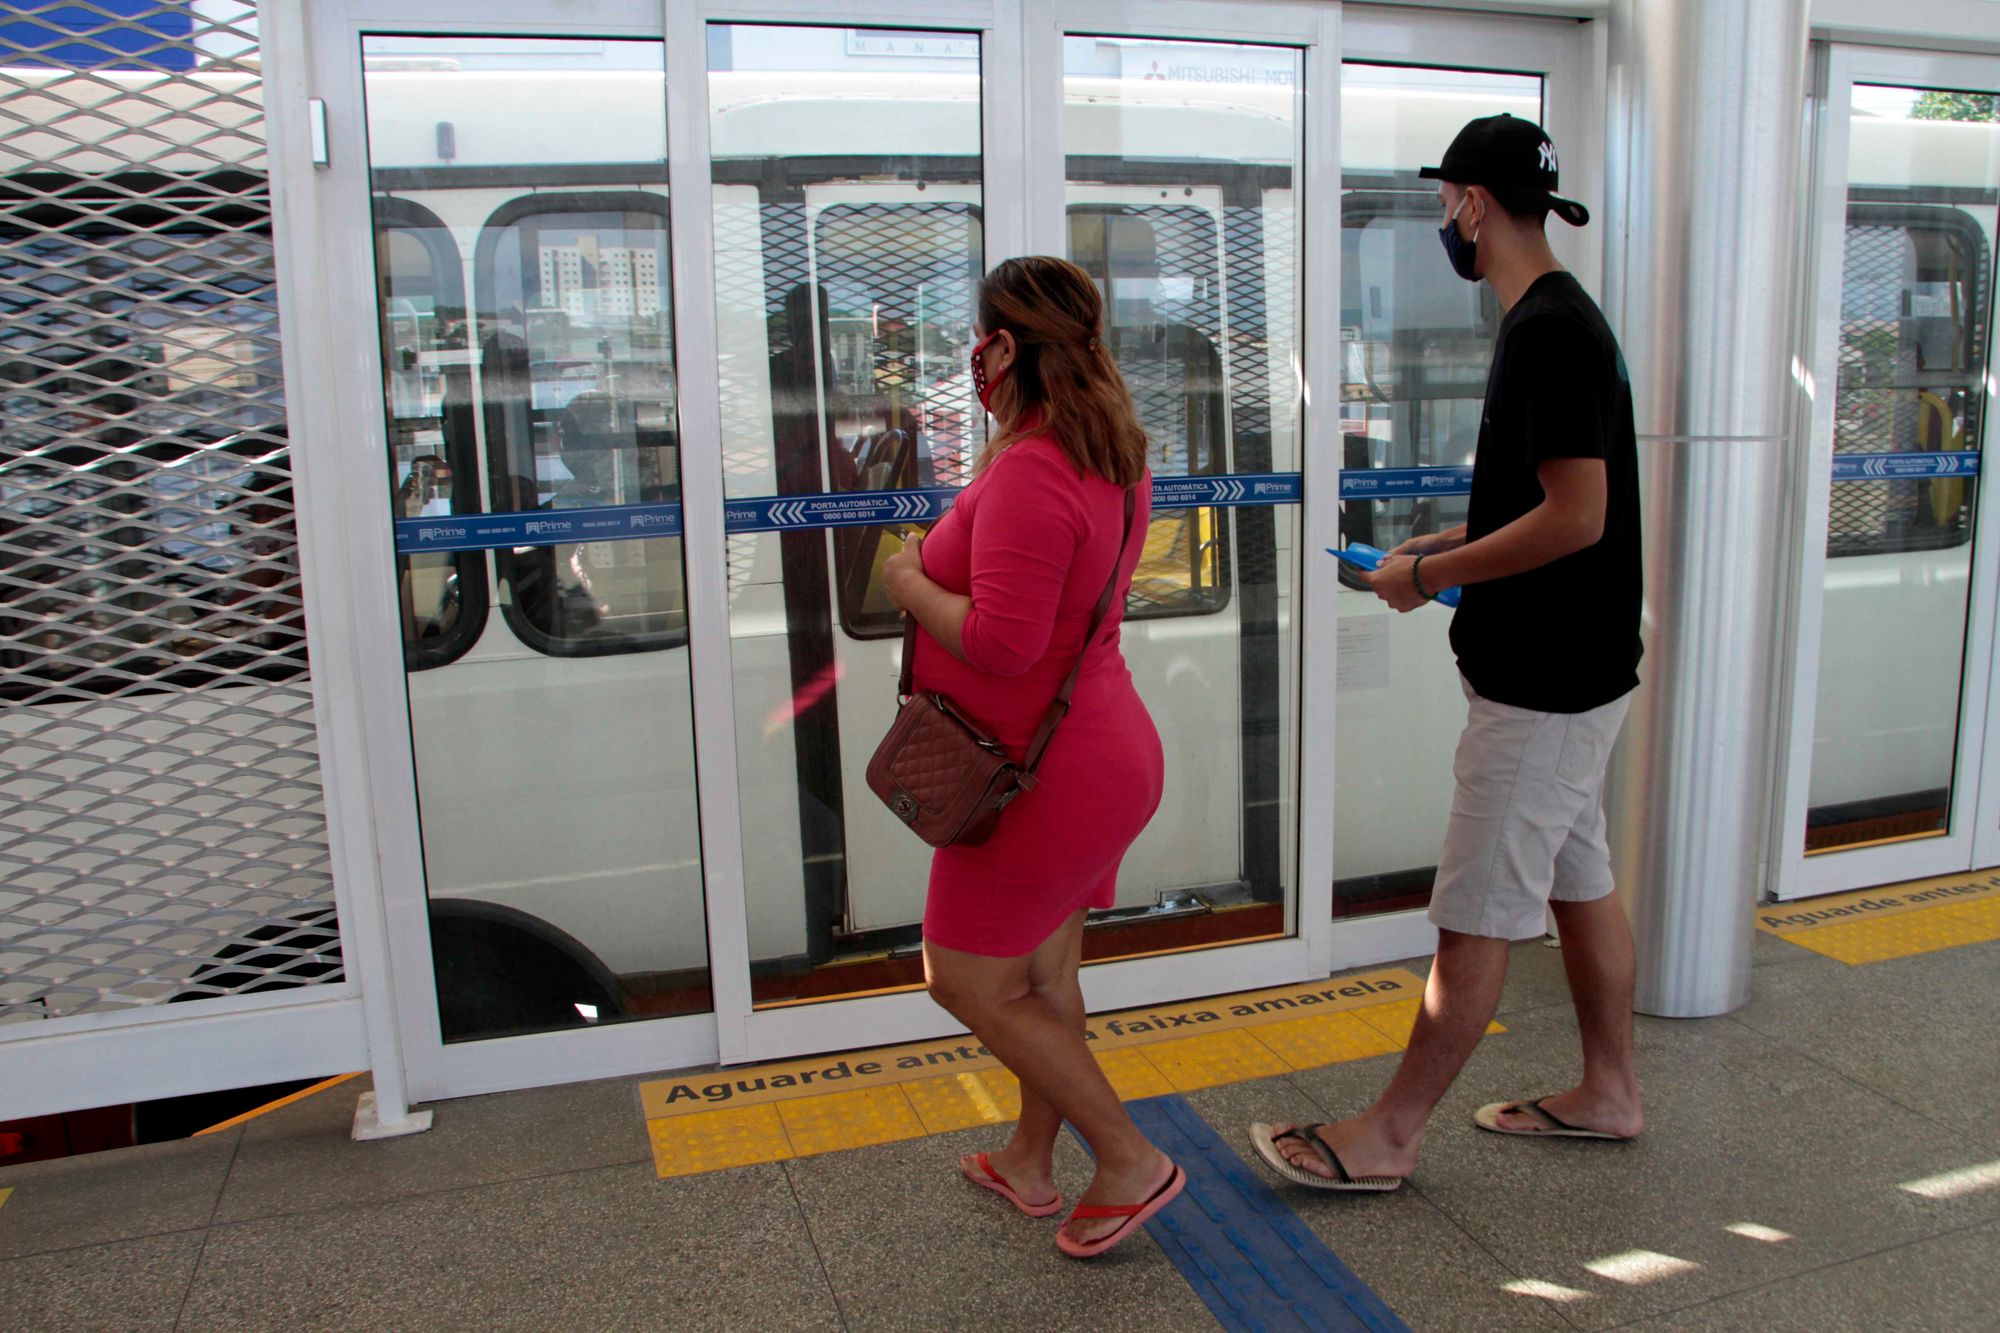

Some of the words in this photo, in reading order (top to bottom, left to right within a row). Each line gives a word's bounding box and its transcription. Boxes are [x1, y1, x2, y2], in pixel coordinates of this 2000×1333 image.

[1168, 65, 1255, 84] MITSUBISHI
[1537, 141, 1558, 172] NY
[1163, 482, 1209, 491] AUTOMÁTICA
[1266, 481, 1292, 491] Prime
[1353, 478, 1378, 487] Prime
[1431, 476, 1455, 484] Prime
[1180, 493, 1197, 501] 6014
[811, 501, 837, 510] PORTA
[839, 498, 889, 508] AUTOMÁTICA
[727, 510, 757, 520] Prime
[823, 512, 841, 520] 0800
[843, 511, 856, 519] 600
[858, 510, 876, 518] 6014
[434, 527, 467, 537] Prime
[540, 521, 572, 530] Prime
[644, 513, 676, 523] Prime
[1760, 897, 1905, 928] Aguarde
[1903, 881, 1991, 903] antes
[665, 1059, 883, 1105] Aguarde
[896, 1041, 996, 1072] ante
[1104, 1005, 1220, 1040] faixa
[1230, 974, 1404, 1022] amarela
